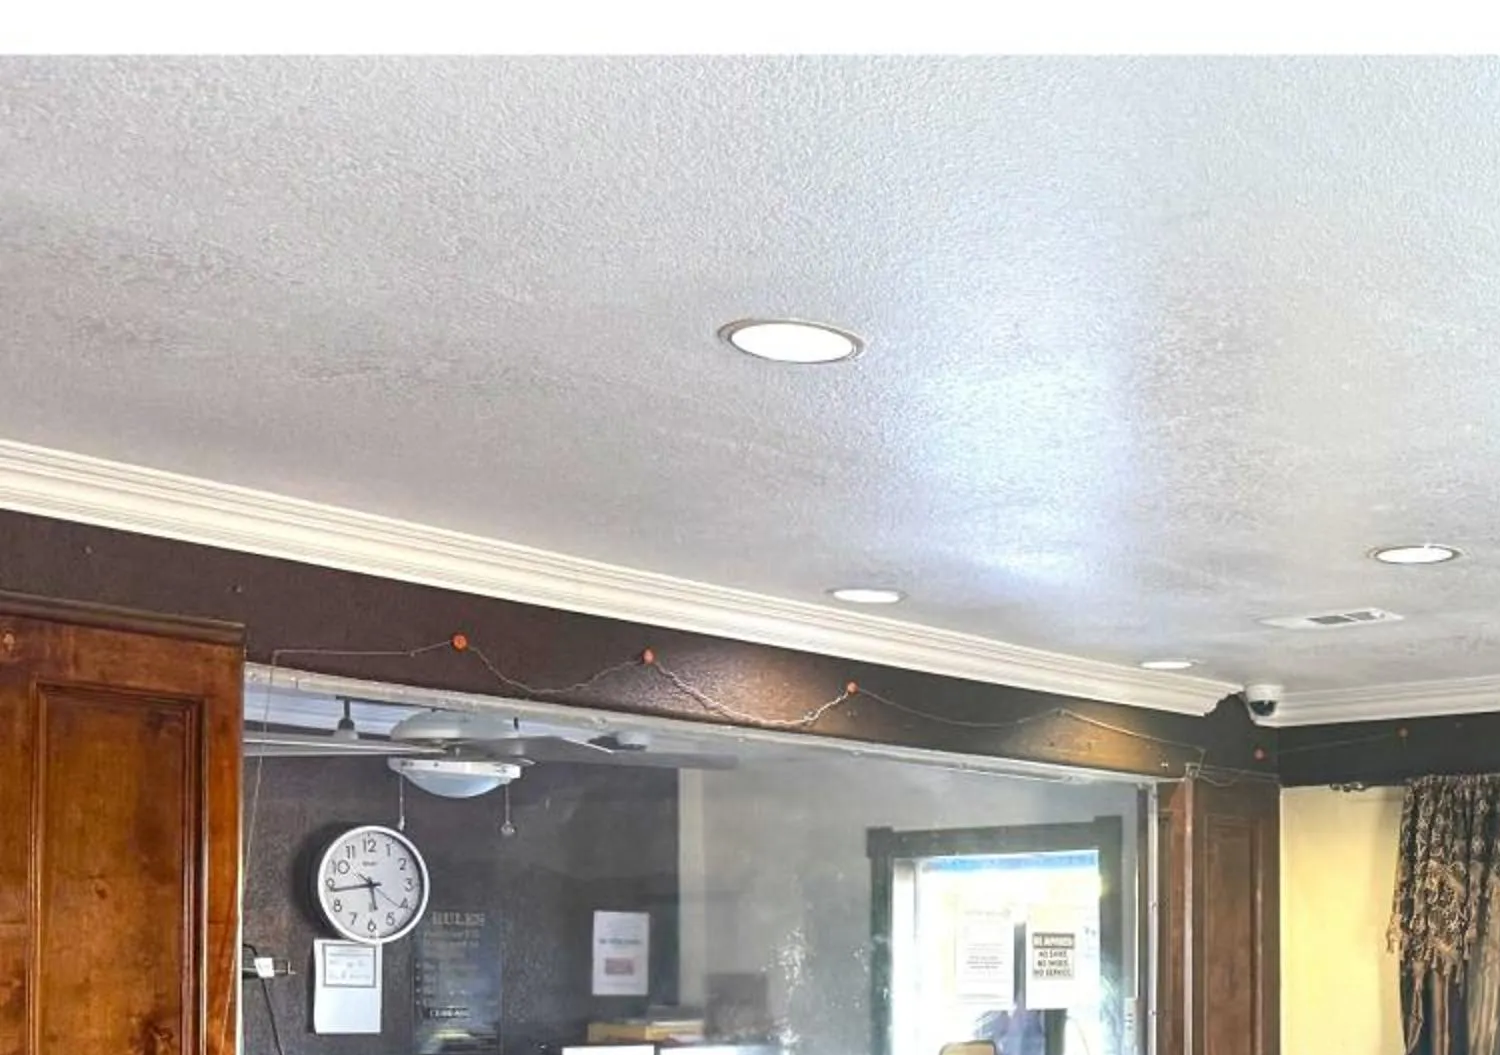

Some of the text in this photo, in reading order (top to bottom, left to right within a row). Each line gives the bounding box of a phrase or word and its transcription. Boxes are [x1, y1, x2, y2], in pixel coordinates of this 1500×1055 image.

[345, 844, 355, 859] 11
[362, 839, 377, 853] 12
[385, 843, 391, 857] 1
[331, 859, 350, 875] 10
[398, 857, 407, 871] 2
[325, 878, 335, 891] 9
[404, 878, 414, 892] 3
[333, 898, 342, 913] 8
[399, 897, 409, 909] 4
[348, 911, 358, 926] 7
[367, 918, 377, 933] 6
[386, 911, 395, 926] 5
